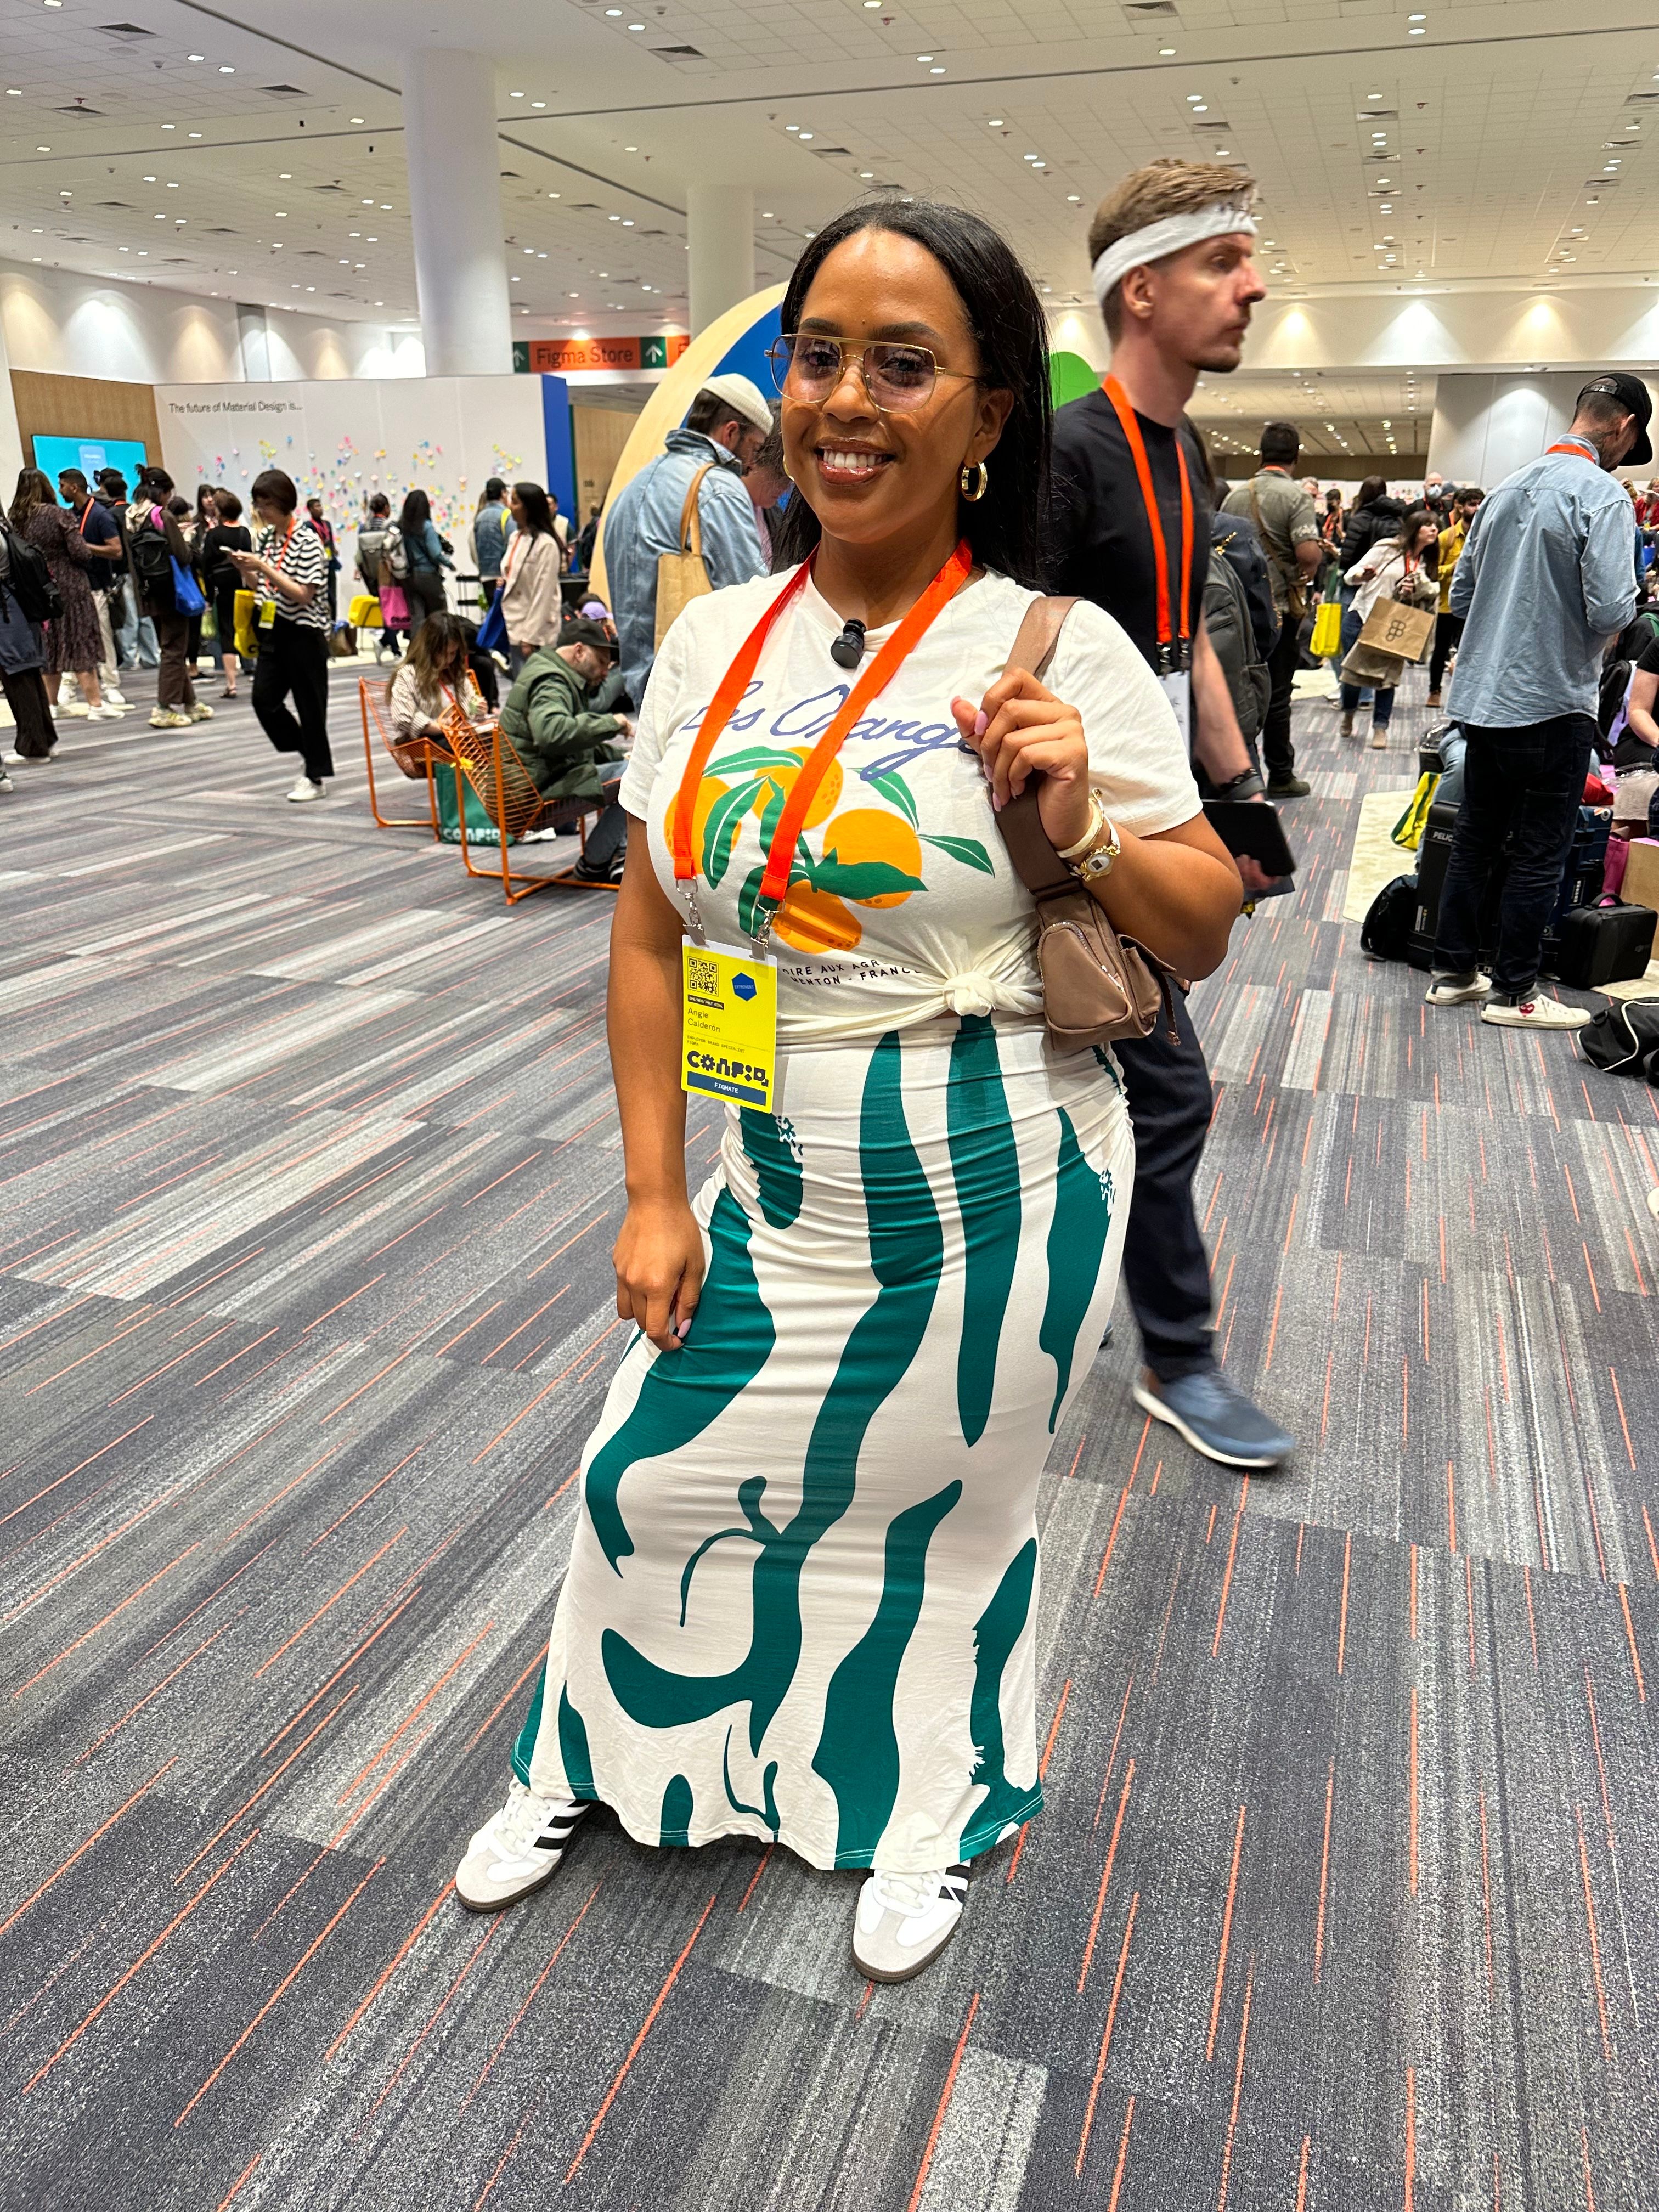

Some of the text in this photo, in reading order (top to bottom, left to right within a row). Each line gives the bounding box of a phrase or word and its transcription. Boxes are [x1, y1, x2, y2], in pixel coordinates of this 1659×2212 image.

[536, 346, 633, 368] Figma Store
[169, 402, 184, 413] The
[187, 402, 211, 413] future
[212, 402, 221, 412] of
[222, 402, 256, 412] Material
[258, 400, 286, 413] Design
[679, 680, 979, 782] Ls Oang
[1433, 831, 1454, 842] PELIC
[821, 964, 845, 974] AUX
[852, 960, 887, 969] AGR
[860, 967, 922, 981] FRANC
[687, 1007, 709, 1019] Angie
[687, 1018, 720, 1032] Calderón
[714, 1082, 739, 1094] FIGMATE
